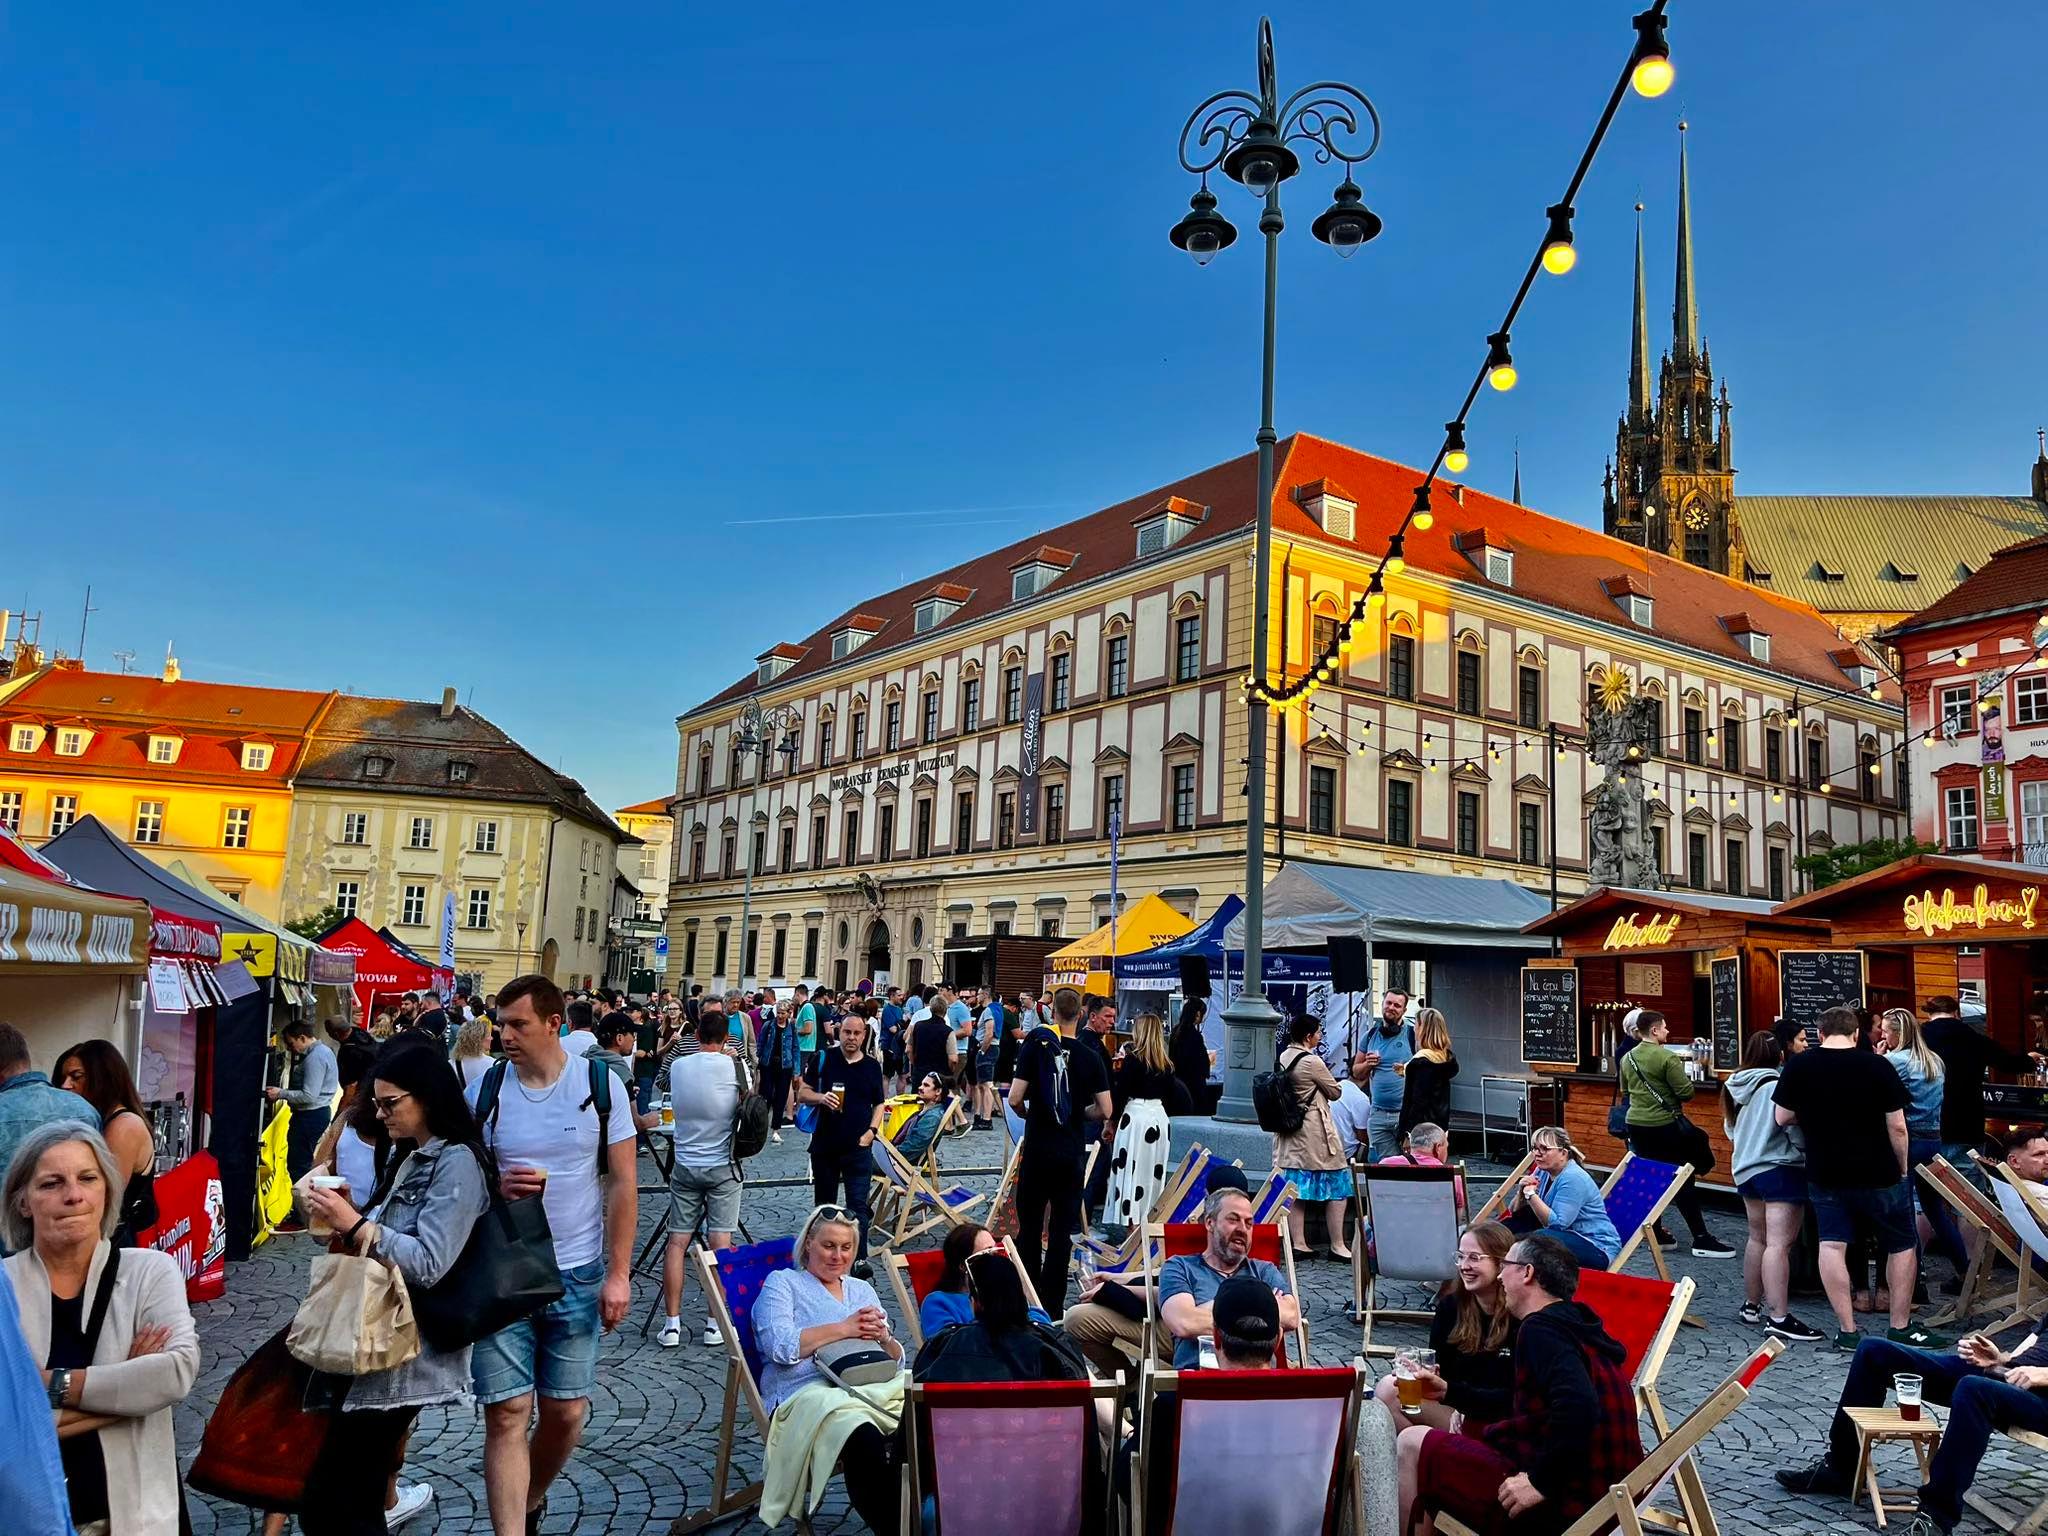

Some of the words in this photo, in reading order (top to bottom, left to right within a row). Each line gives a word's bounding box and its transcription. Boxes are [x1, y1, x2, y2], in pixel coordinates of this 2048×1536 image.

[832, 768, 872, 791] MORAVSKÉ
[877, 761, 910, 781] ZEMSKÉ
[916, 753, 955, 773] MUZEUM
[658, 939, 666, 949] P
[1053, 957, 1090, 972] DUCK&DOG
[1529, 973, 1540, 991] Na
[1542, 979, 1558, 996] čepu
